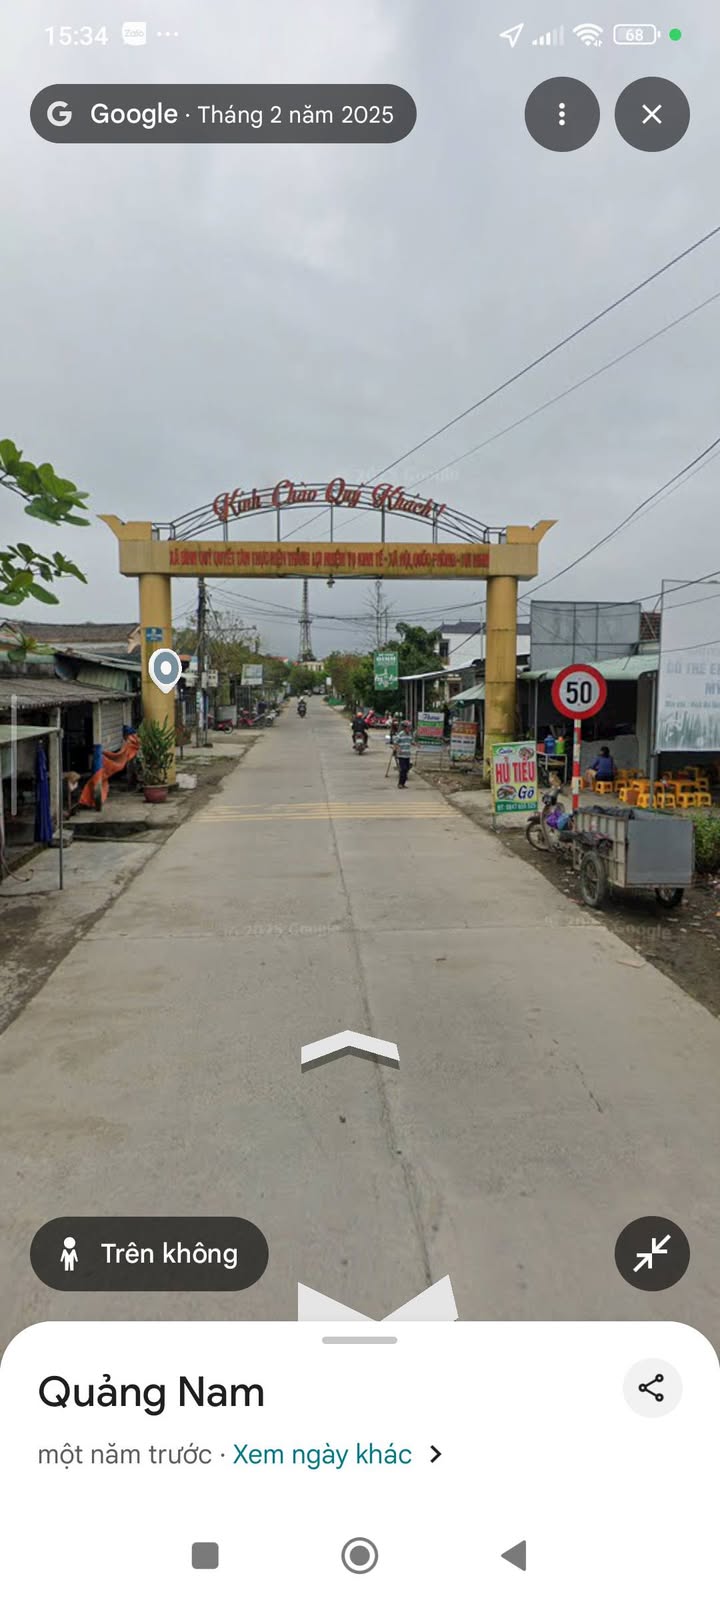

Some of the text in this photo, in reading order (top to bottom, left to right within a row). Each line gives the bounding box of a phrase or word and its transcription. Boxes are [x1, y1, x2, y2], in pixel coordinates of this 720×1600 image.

[272, 479, 318, 508] Chào
[325, 477, 364, 508] Quý
[566, 681, 592, 704] 50
